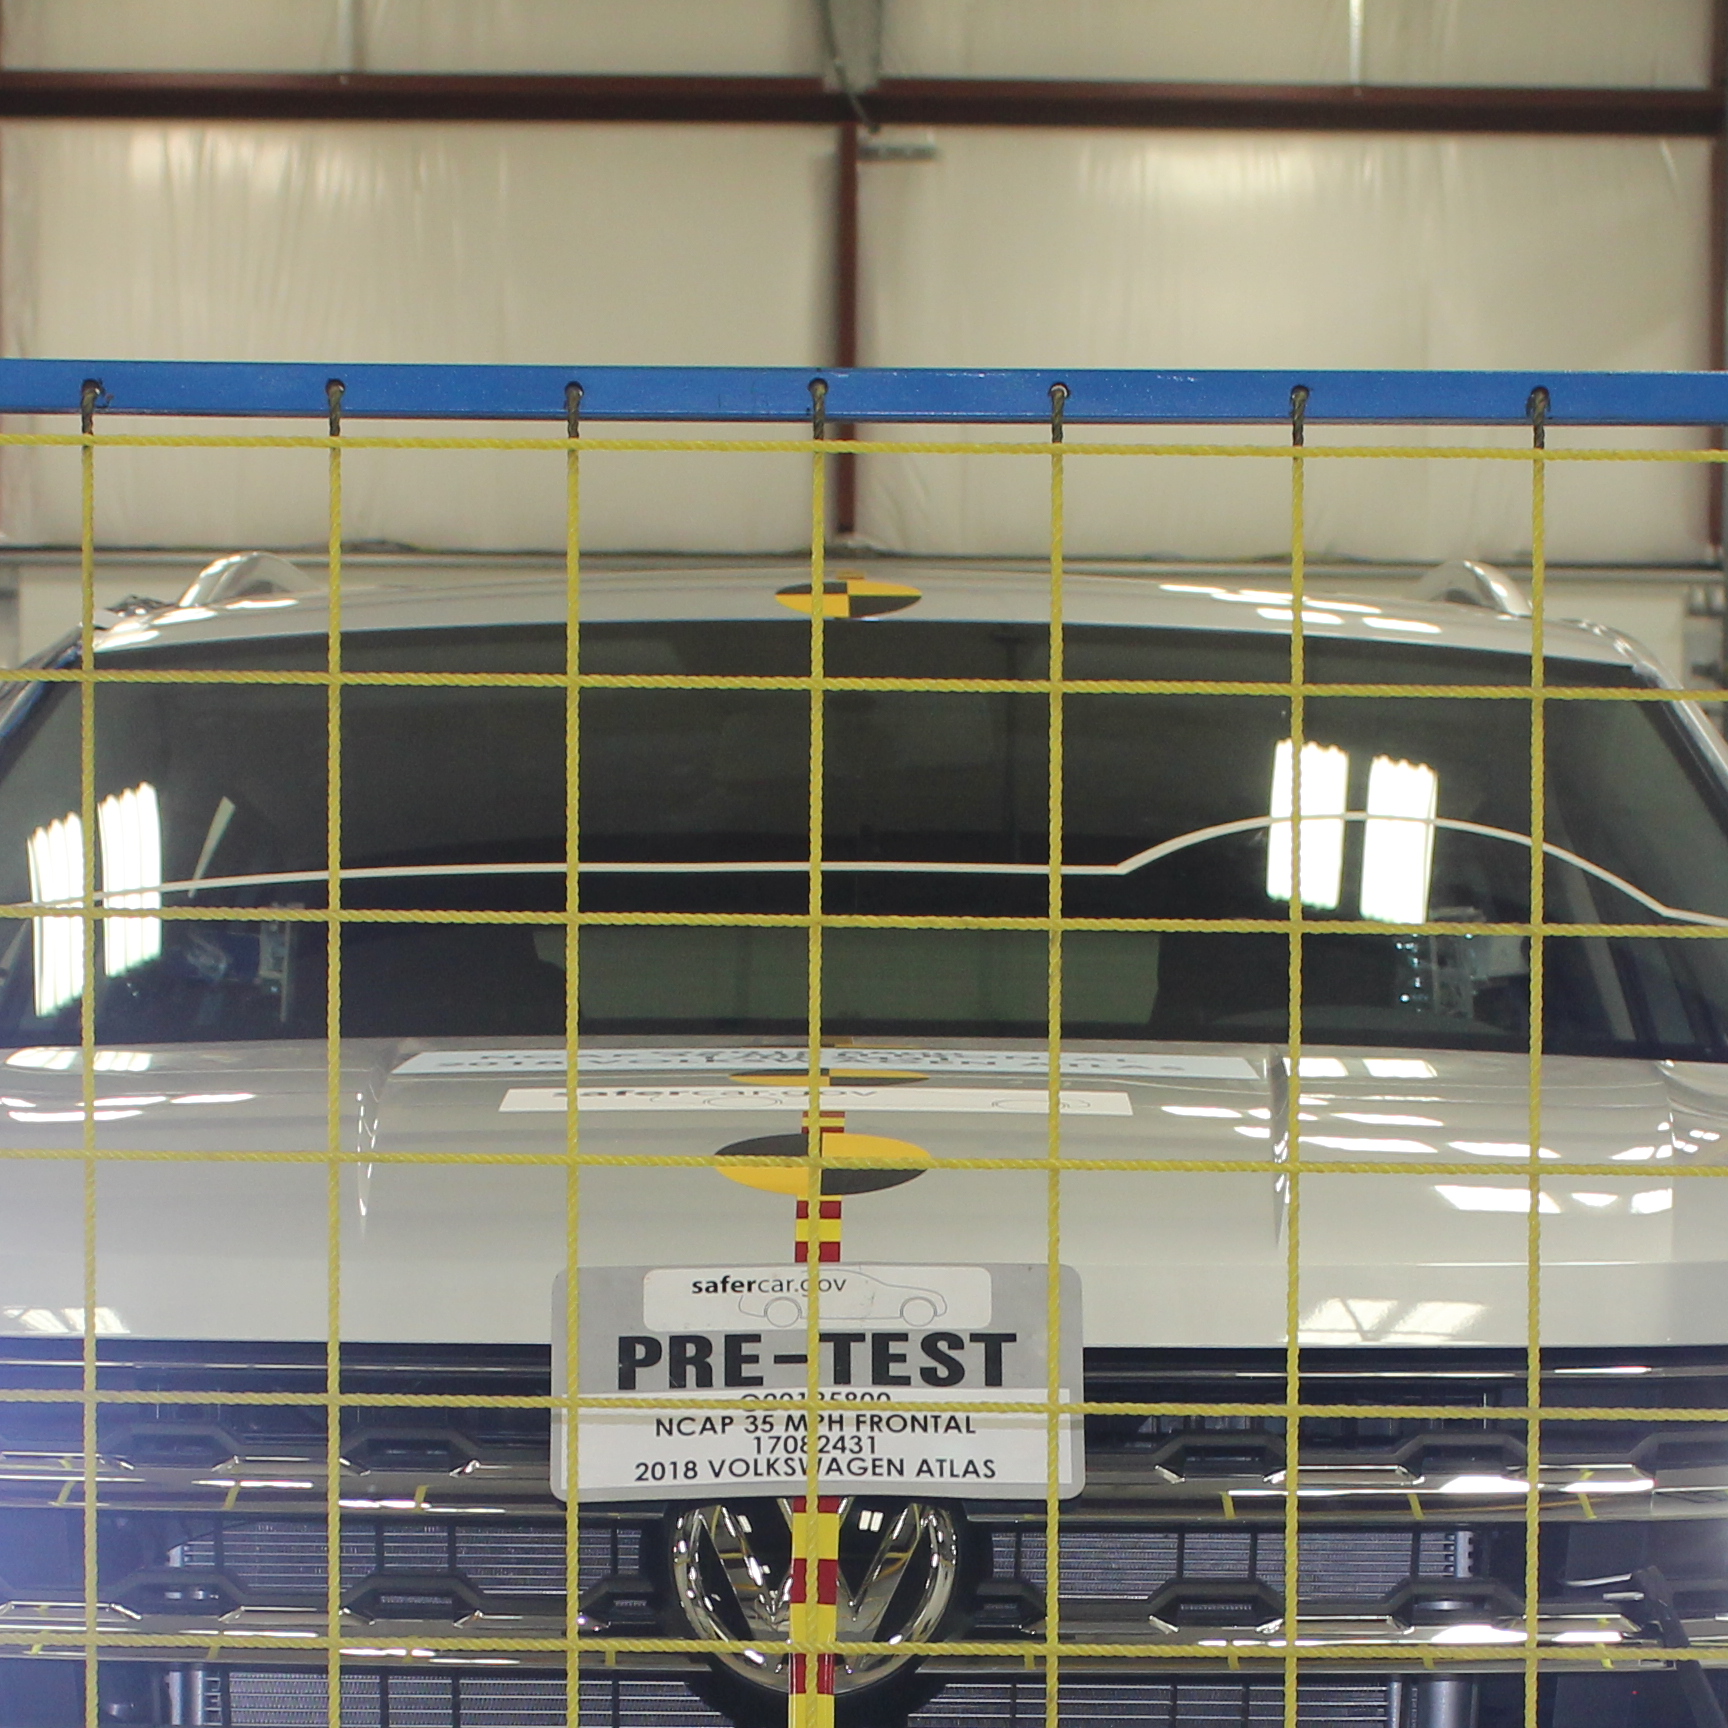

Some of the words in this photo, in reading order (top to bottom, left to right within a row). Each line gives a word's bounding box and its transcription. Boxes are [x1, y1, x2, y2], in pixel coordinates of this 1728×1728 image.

[692, 1275, 847, 1298] safercar.gov
[617, 1331, 1017, 1390] PRE-TEST
[655, 1415, 735, 1437] NCAP
[744, 1414, 775, 1434] 35
[784, 1413, 844, 1432] MPH
[856, 1414, 977, 1434] FRONTAL
[752, 1434, 876, 1455] 17082431
[634, 1460, 698, 1482] 2018
[707, 1456, 905, 1478] VOLKSWAGEN
[915, 1458, 997, 1479] ATLAS
